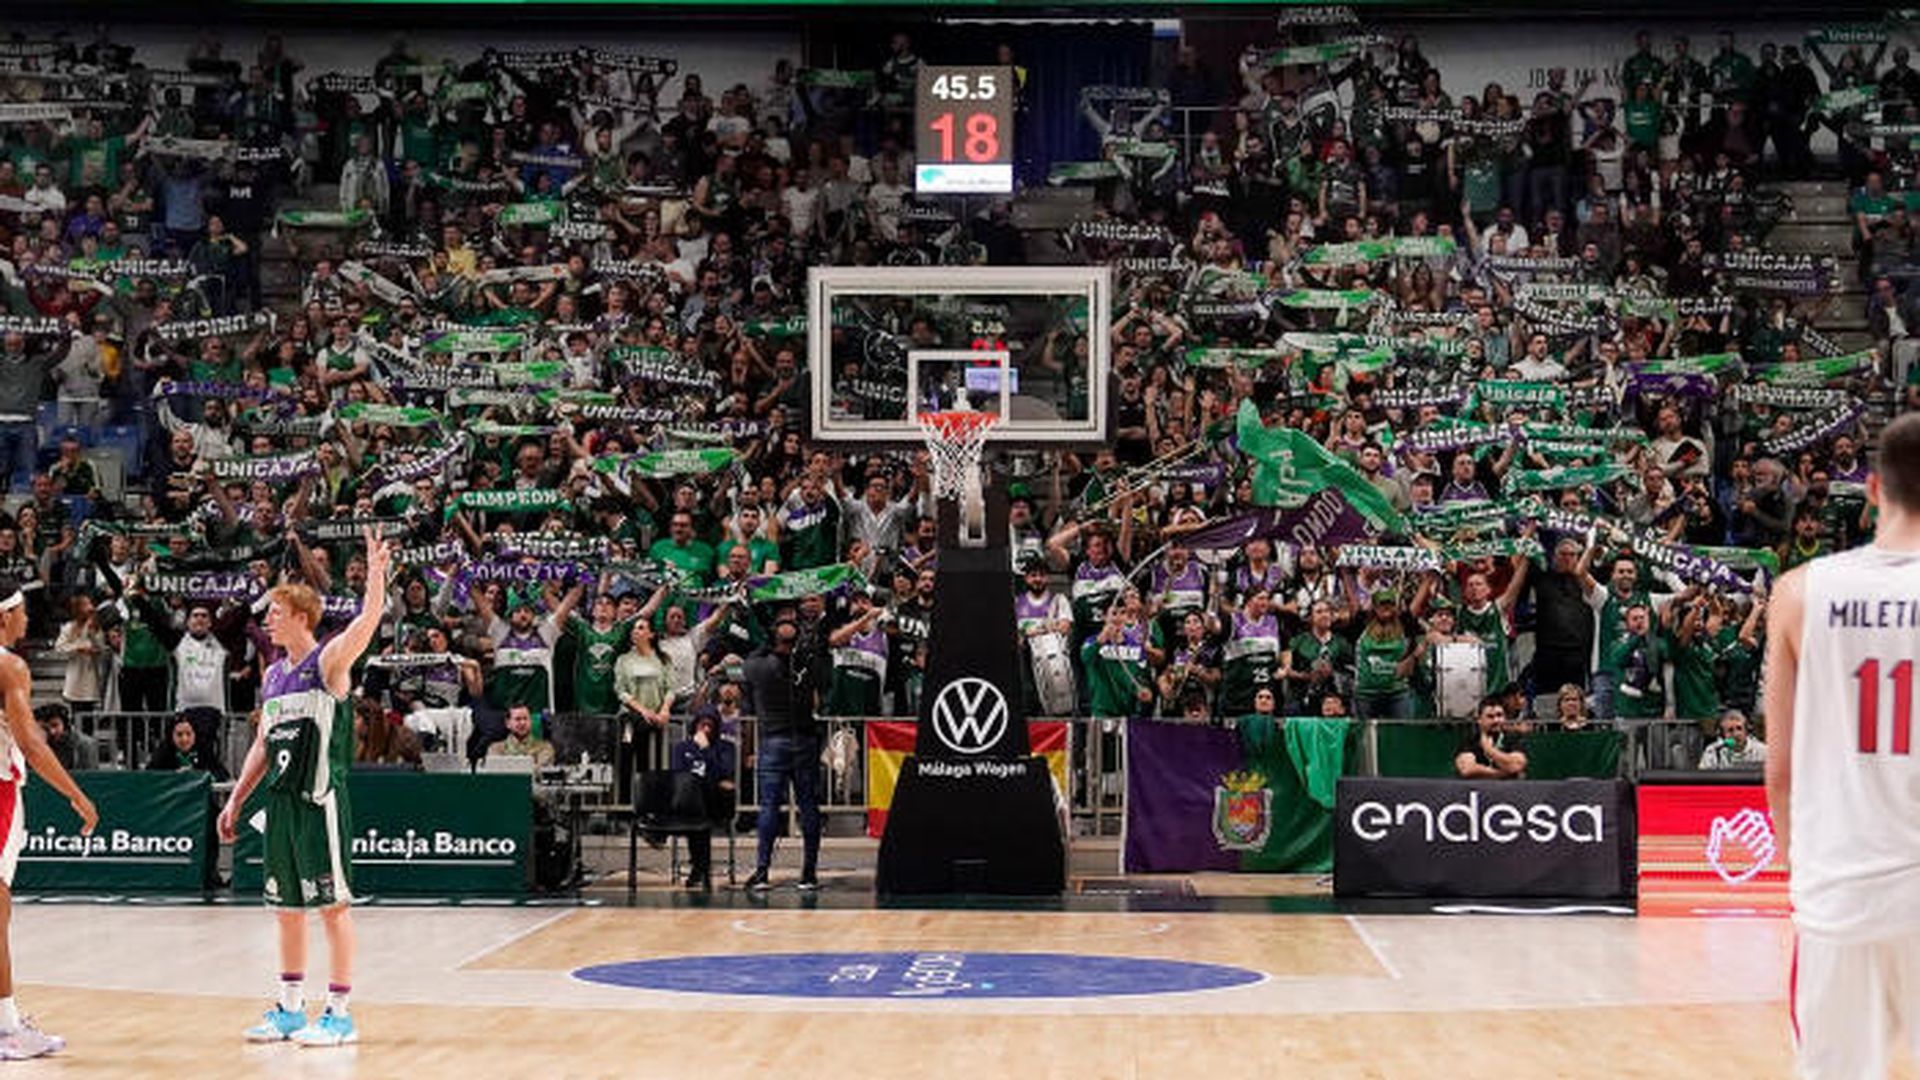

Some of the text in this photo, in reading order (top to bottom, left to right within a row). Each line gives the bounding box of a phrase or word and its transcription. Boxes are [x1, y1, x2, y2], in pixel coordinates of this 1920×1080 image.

[932, 74, 996, 100] 45.5
[929, 112, 999, 163] 18
[1081, 221, 1163, 241] UNICAJA
[1723, 252, 1814, 271] UNICAJA
[1513, 293, 1600, 332] UNICAJA
[625, 357, 717, 388] UNICAJA
[1479, 383, 1557, 402] Unicaja
[583, 404, 675, 422] UNICAJA
[1413, 422, 1511, 449] UNICAJA
[1764, 404, 1854, 454] UNICAJA
[213, 459, 310, 478] UNICAJA
[462, 490, 558, 506] CAMPEON
[1633, 536, 1732, 580] UNICAJA
[143, 573, 248, 593] UNICAJA
[1853, 658, 1913, 755] 11
[277, 749, 291, 775] 9
[918, 761, 1027, 777] Málaga Wagen
[1351, 791, 1603, 842] endesa
[111, 830, 194, 853] Banco
[352, 828, 516, 857] nicaja Banco
